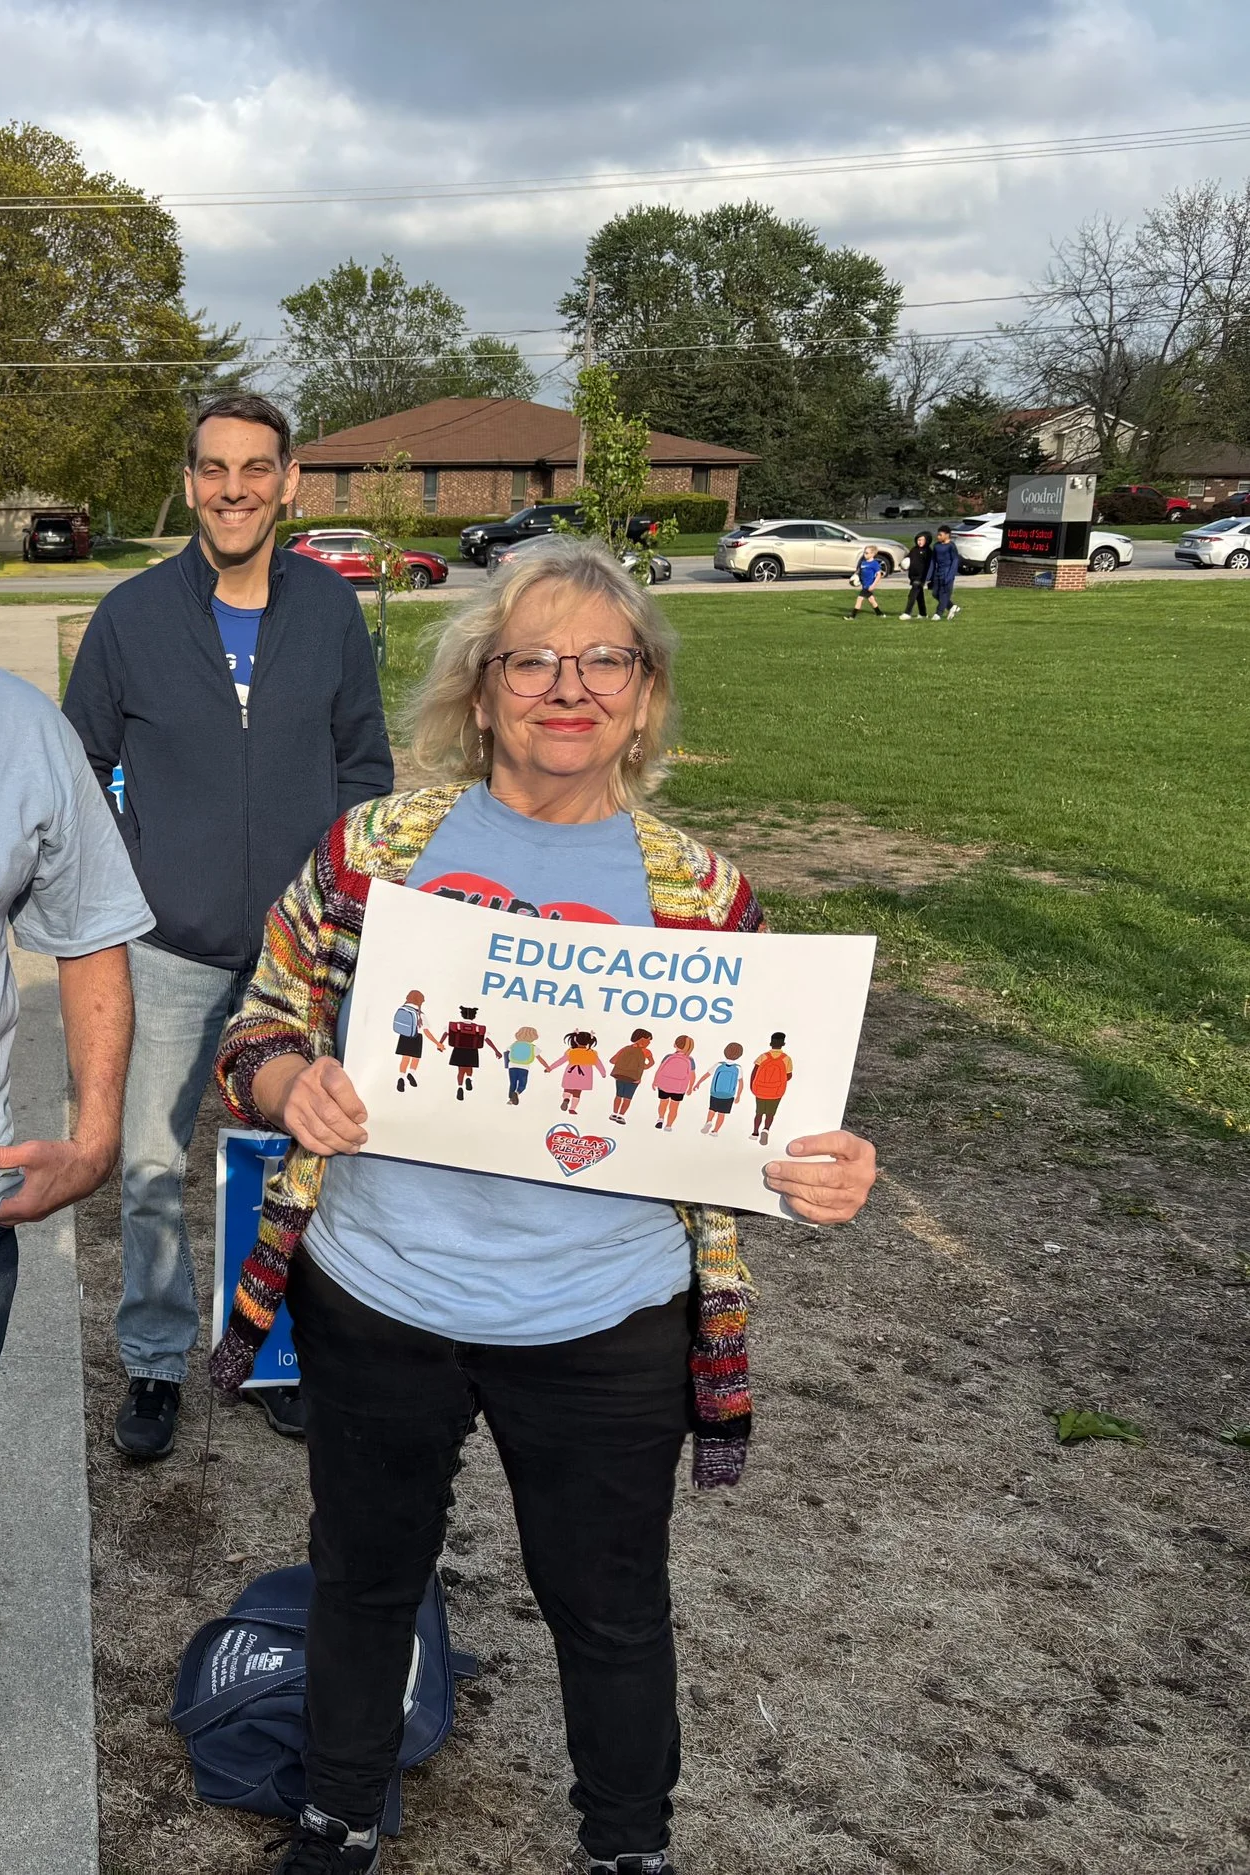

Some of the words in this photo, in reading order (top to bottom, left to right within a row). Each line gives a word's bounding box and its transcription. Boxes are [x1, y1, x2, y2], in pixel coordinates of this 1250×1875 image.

[1021, 487, 1063, 504] Goodrell
[487, 932, 743, 986] EDUCACIÓN
[481, 971, 585, 1009] PARA
[598, 986, 734, 1025] TODOS
[552, 1135, 605, 1149] ESCUELAS
[554, 1153, 596, 1166] UNIDAS!
